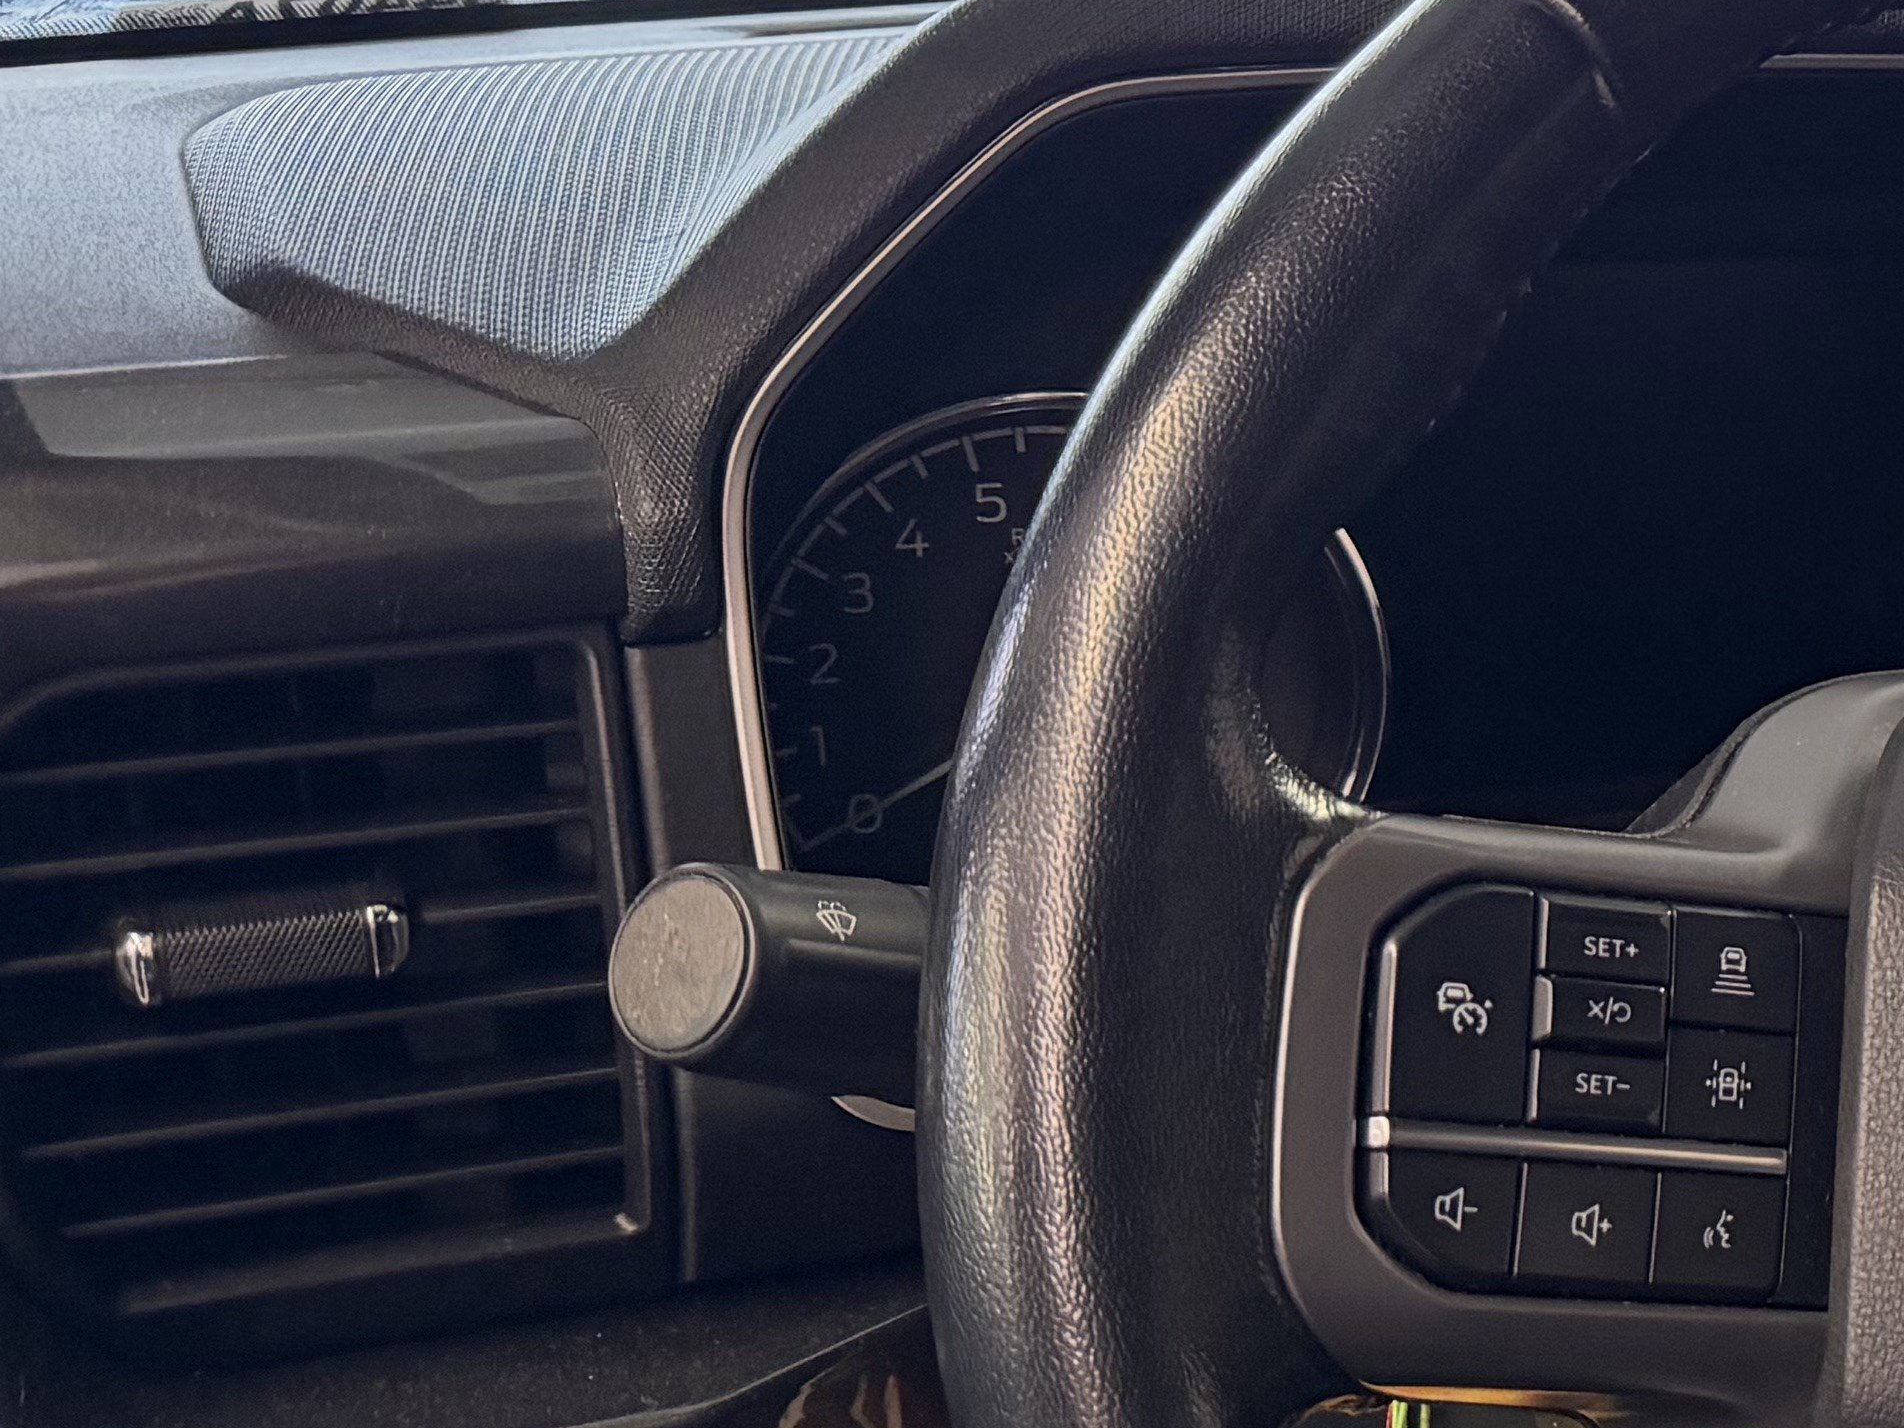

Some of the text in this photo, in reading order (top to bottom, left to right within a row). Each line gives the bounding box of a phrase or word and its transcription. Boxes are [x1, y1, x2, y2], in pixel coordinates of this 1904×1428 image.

[975, 482, 1008, 523] 5
[895, 518, 930, 558] 4
[842, 572, 875, 614] 3
[808, 642, 842, 685] 2
[810, 725, 827, 767] 1
[849, 793, 883, 834] 0
[1583, 935, 1640, 959] SET+
